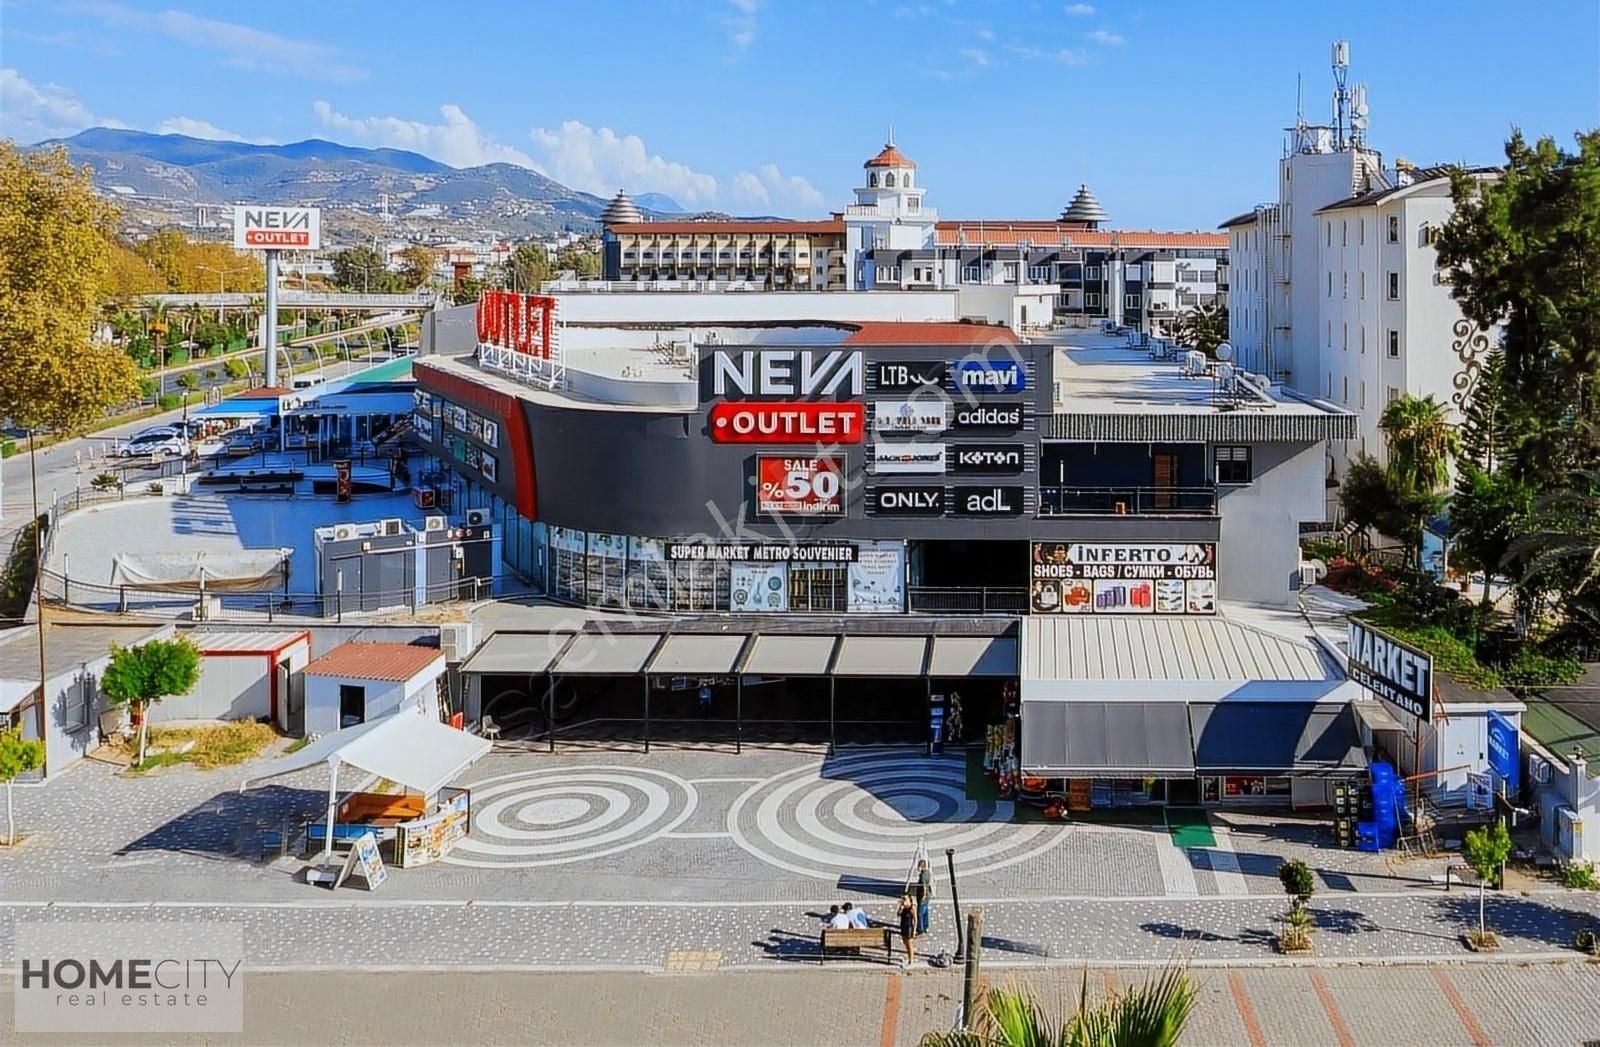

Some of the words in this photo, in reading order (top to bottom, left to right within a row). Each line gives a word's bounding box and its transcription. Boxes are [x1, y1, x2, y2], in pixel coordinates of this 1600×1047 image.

[245, 211, 309, 228] NEVA
[254, 233, 307, 243] OUTLET
[714, 351, 863, 395] NEVA
[881, 366, 908, 385] LTB
[961, 366, 1018, 385] mavi
[733, 412, 856, 434] OUTLET
[958, 408, 1019, 424] adidas
[784, 460, 817, 471] SALE
[763, 471, 839, 499] %50
[967, 488, 1011, 511] adL
[670, 545, 705, 560] SUPER
[706, 545, 750, 560] MARKET
[753, 545, 789, 560] METRO
[792, 545, 852, 560] SOUVENIER
[1033, 565, 1073, 578] SHOES
[1083, 565, 1115, 578] BAGS
[1124, 565, 1164, 578] СУМКИ
[1174, 565, 1214, 578] ОБУВЬ
[1349, 623, 1429, 697] MARKET
